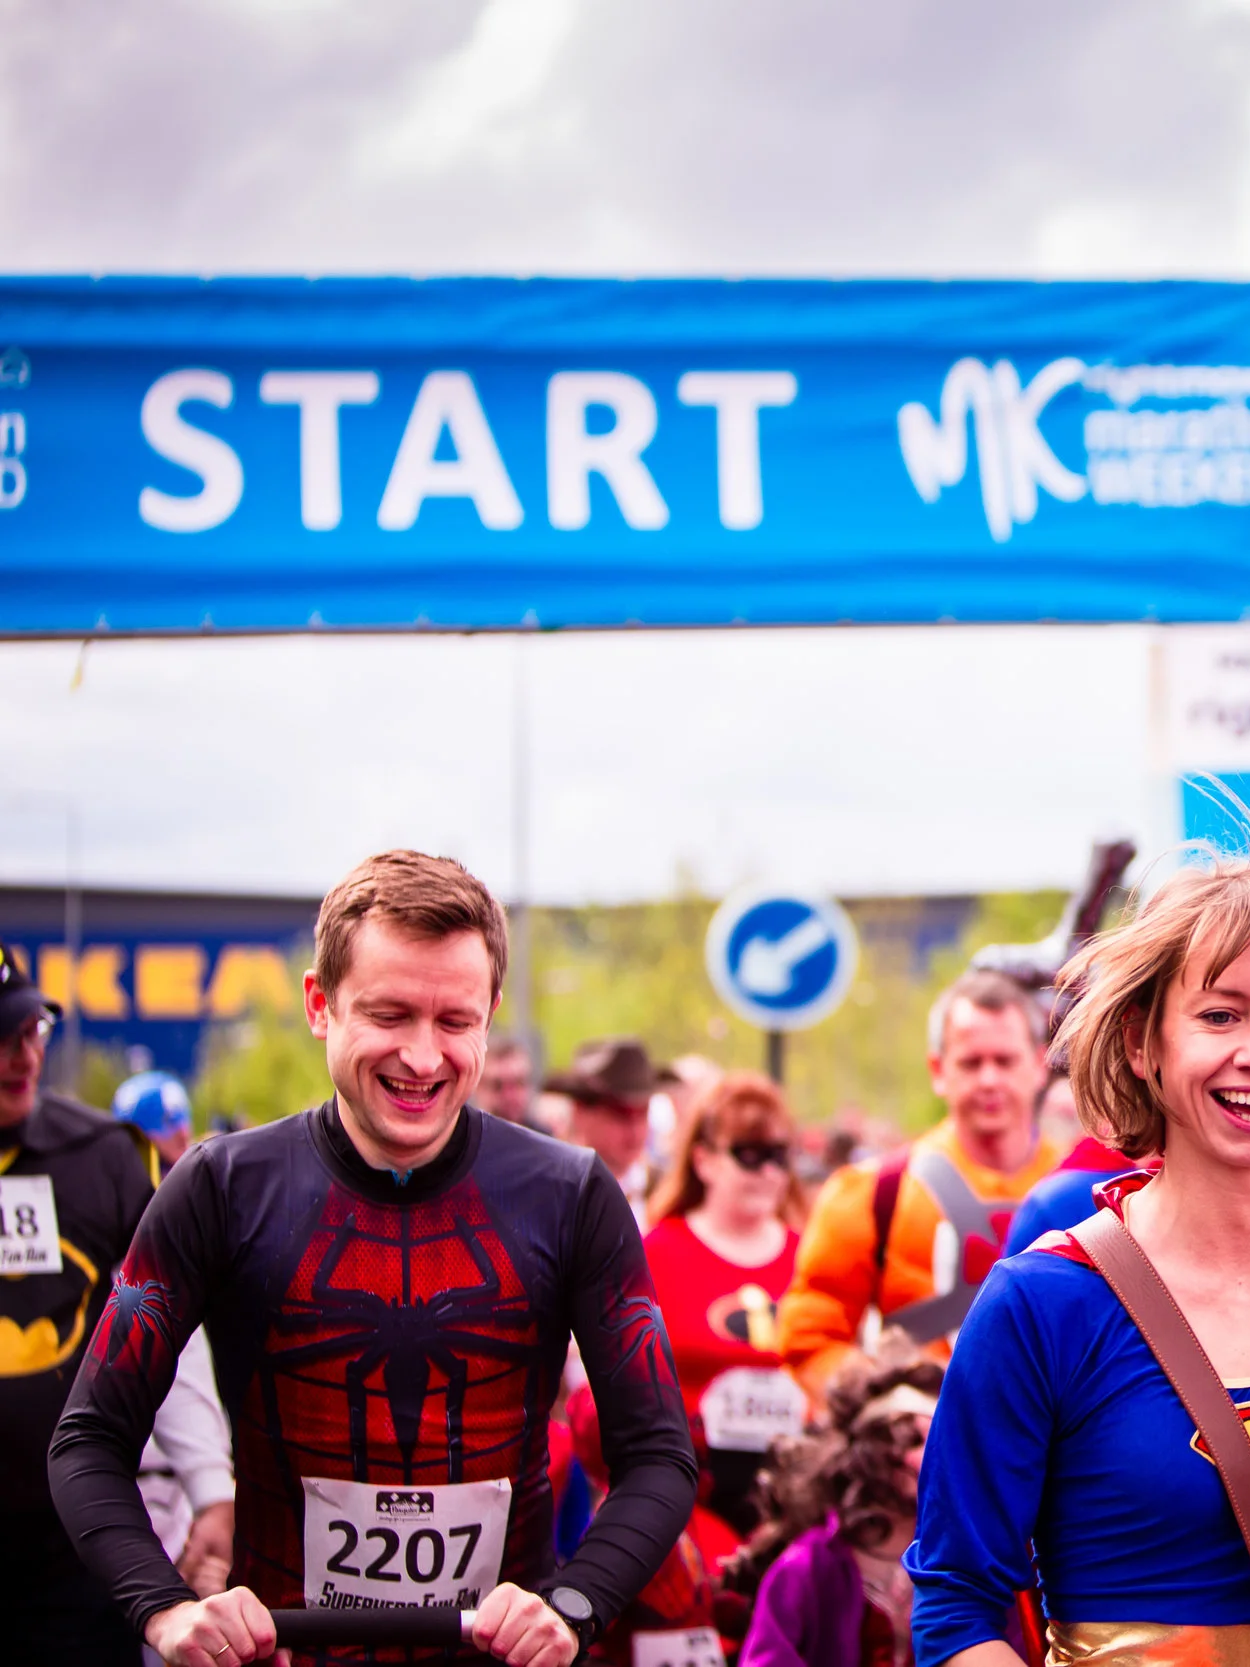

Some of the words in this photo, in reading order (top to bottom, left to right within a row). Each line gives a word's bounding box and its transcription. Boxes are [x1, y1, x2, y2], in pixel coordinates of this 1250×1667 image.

[139, 368, 798, 533] START
[898, 357, 1087, 543] MK
[8, 944, 293, 1020] KEA
[326, 1520, 482, 1583] 2207
